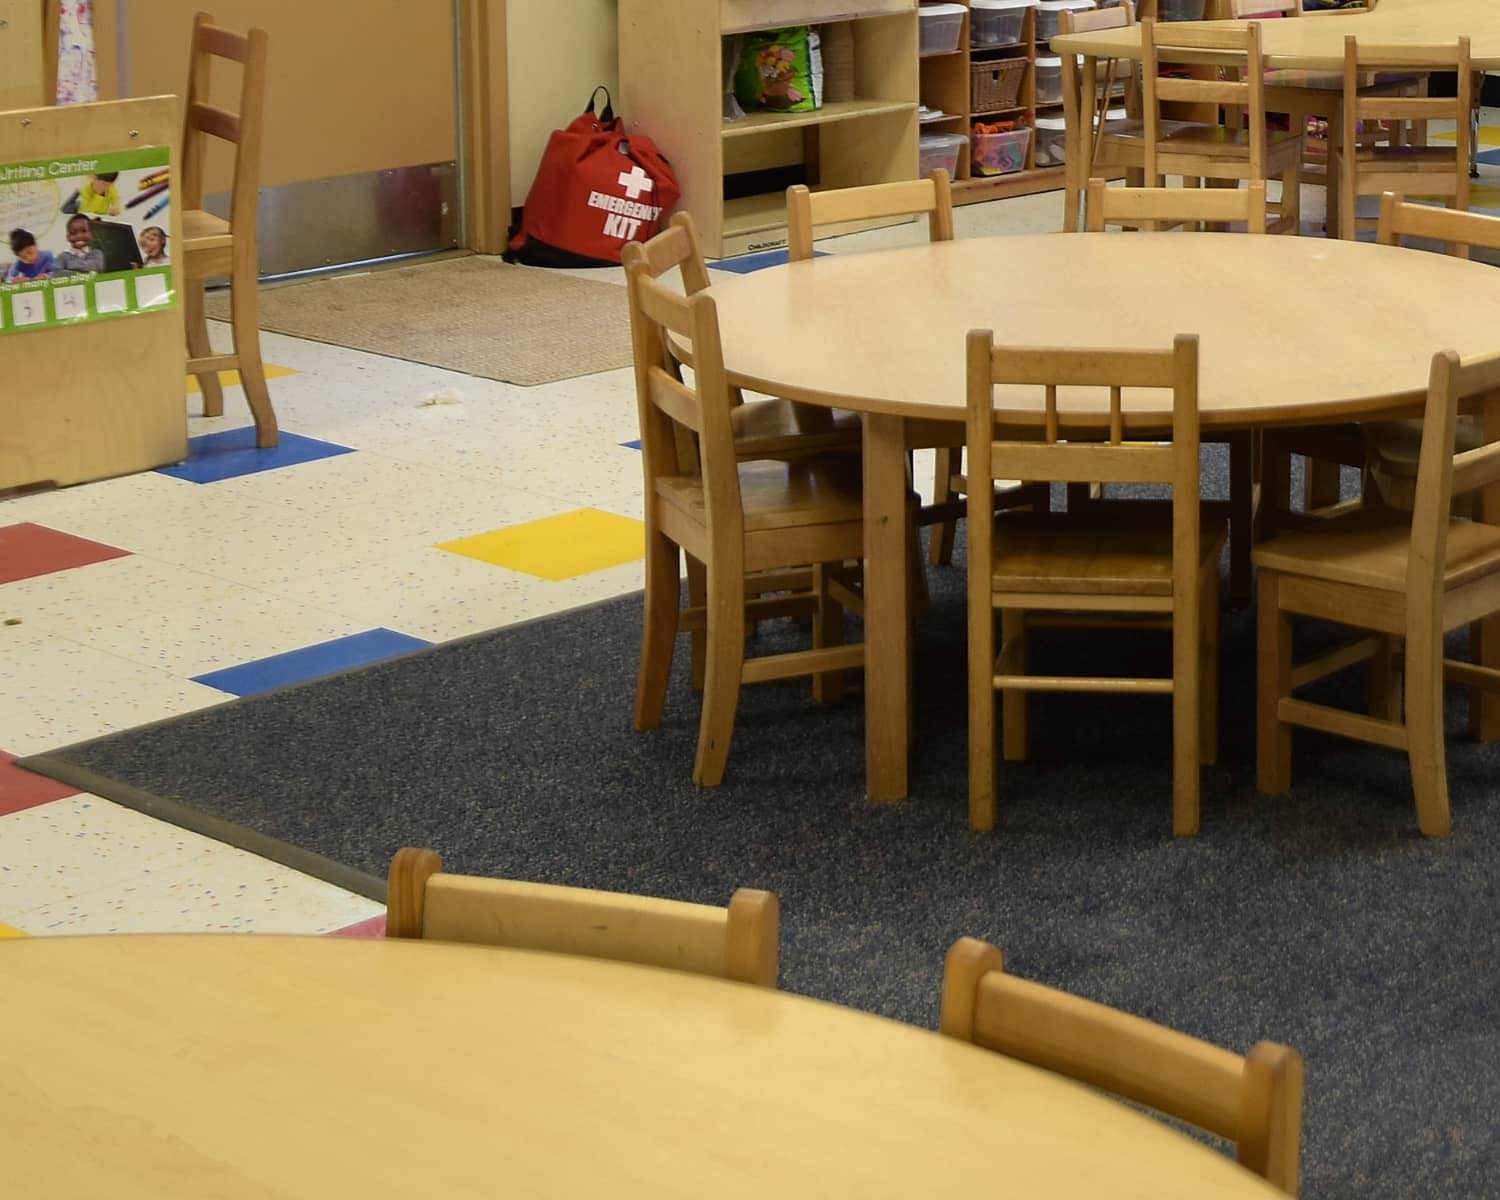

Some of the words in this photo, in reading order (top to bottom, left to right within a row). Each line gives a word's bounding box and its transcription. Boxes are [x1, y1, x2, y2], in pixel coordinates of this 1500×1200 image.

[48, 160, 98, 176] Center
[587, 190, 664, 222] EMERGENCY
[602, 212, 643, 241] KIT
